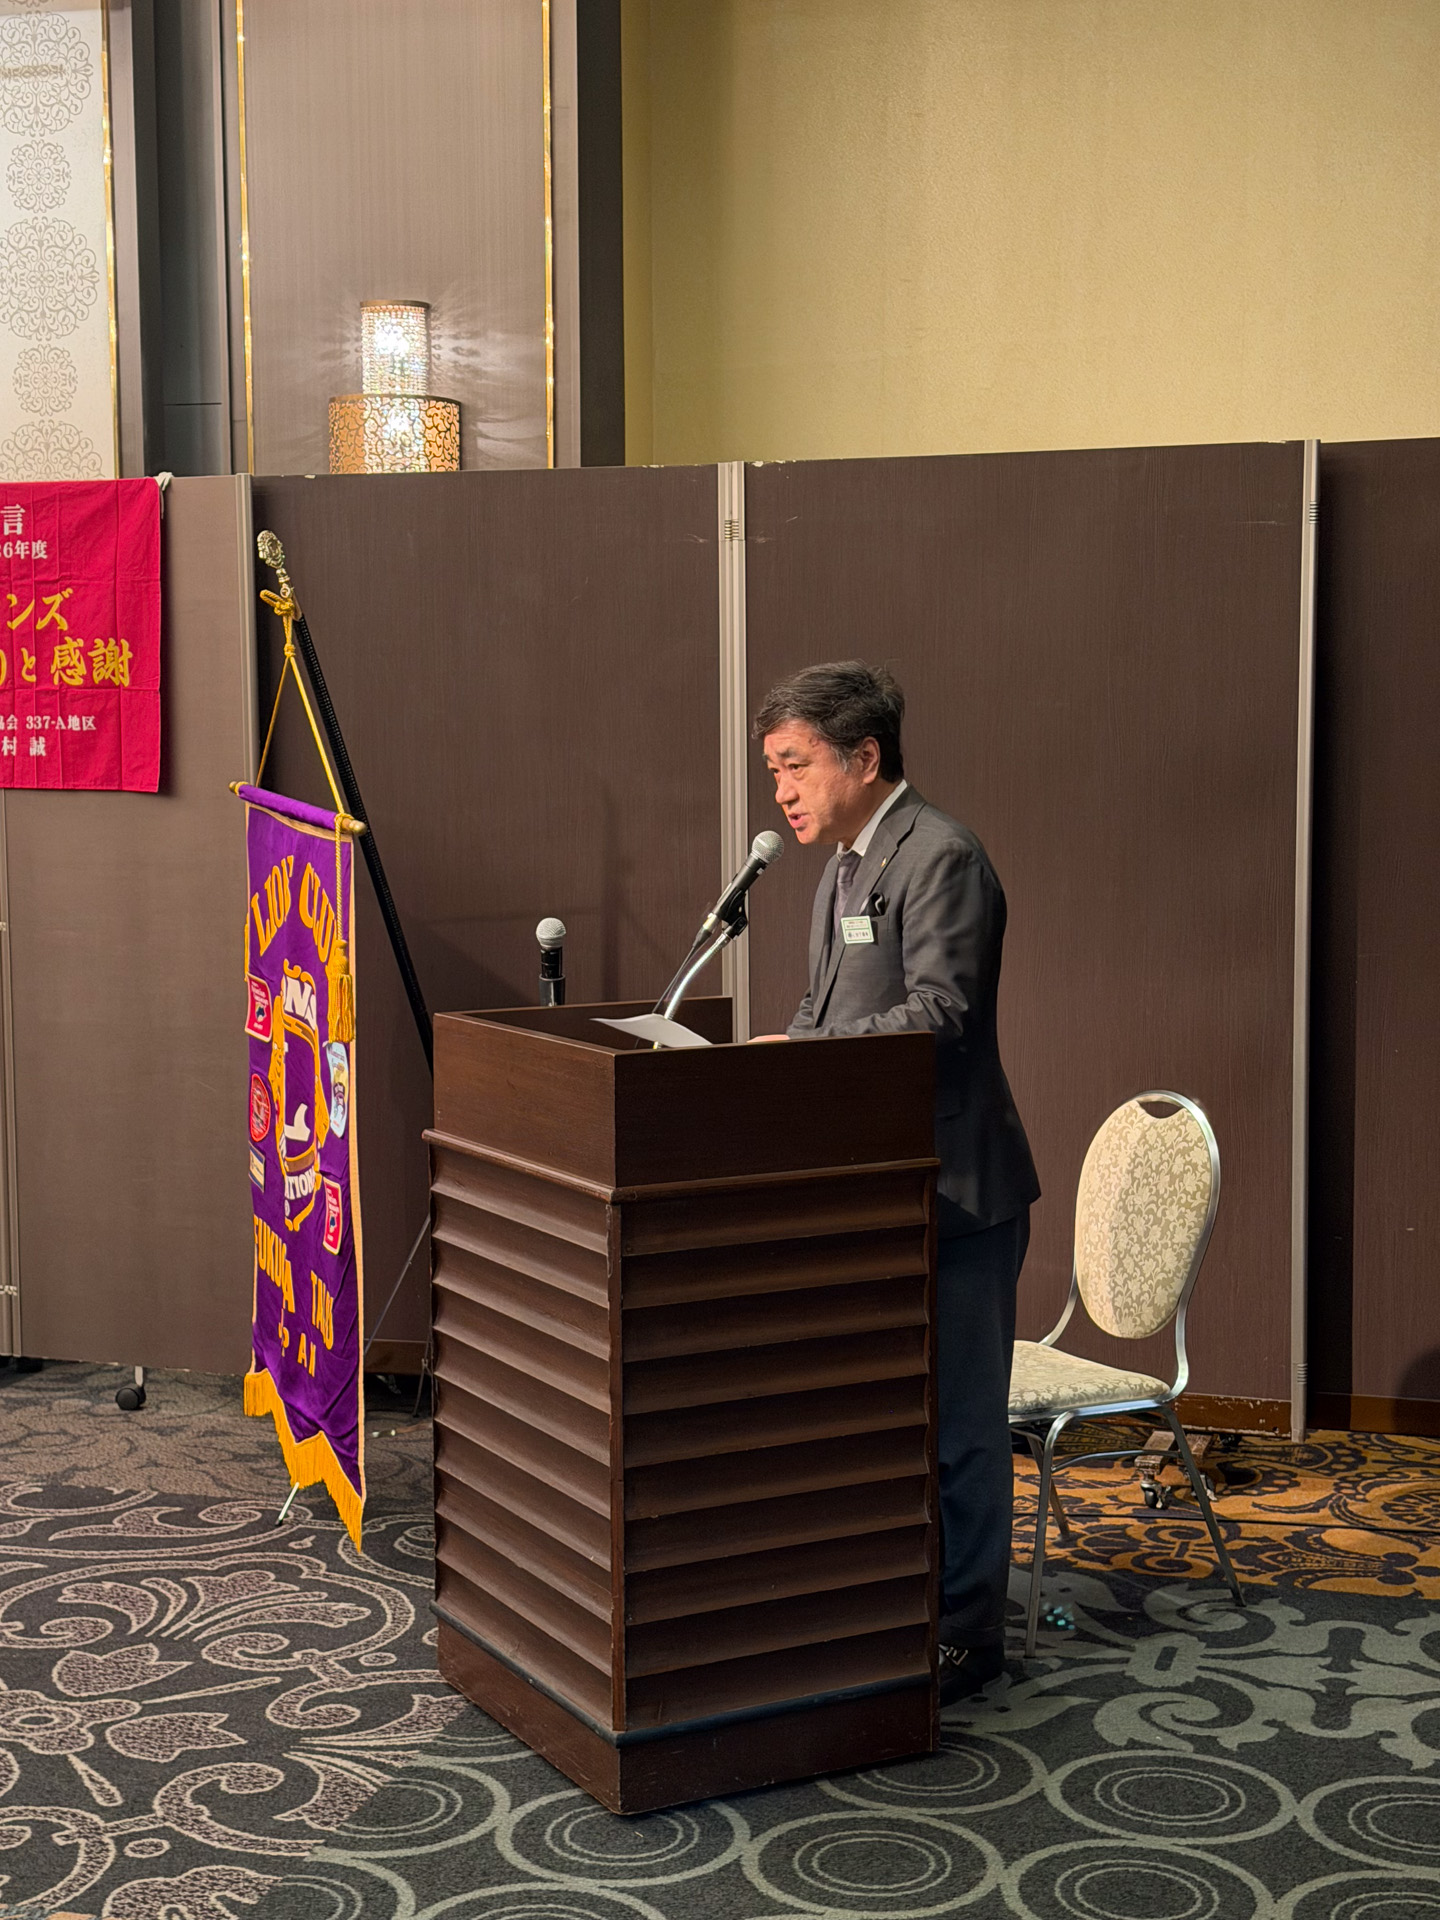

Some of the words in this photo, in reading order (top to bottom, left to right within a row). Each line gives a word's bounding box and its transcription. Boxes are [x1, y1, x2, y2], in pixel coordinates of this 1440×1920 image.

[0, 504, 26, 536] 言
[0, 540, 48, 560] 6年度
[6, 587, 73, 631] ンズ
